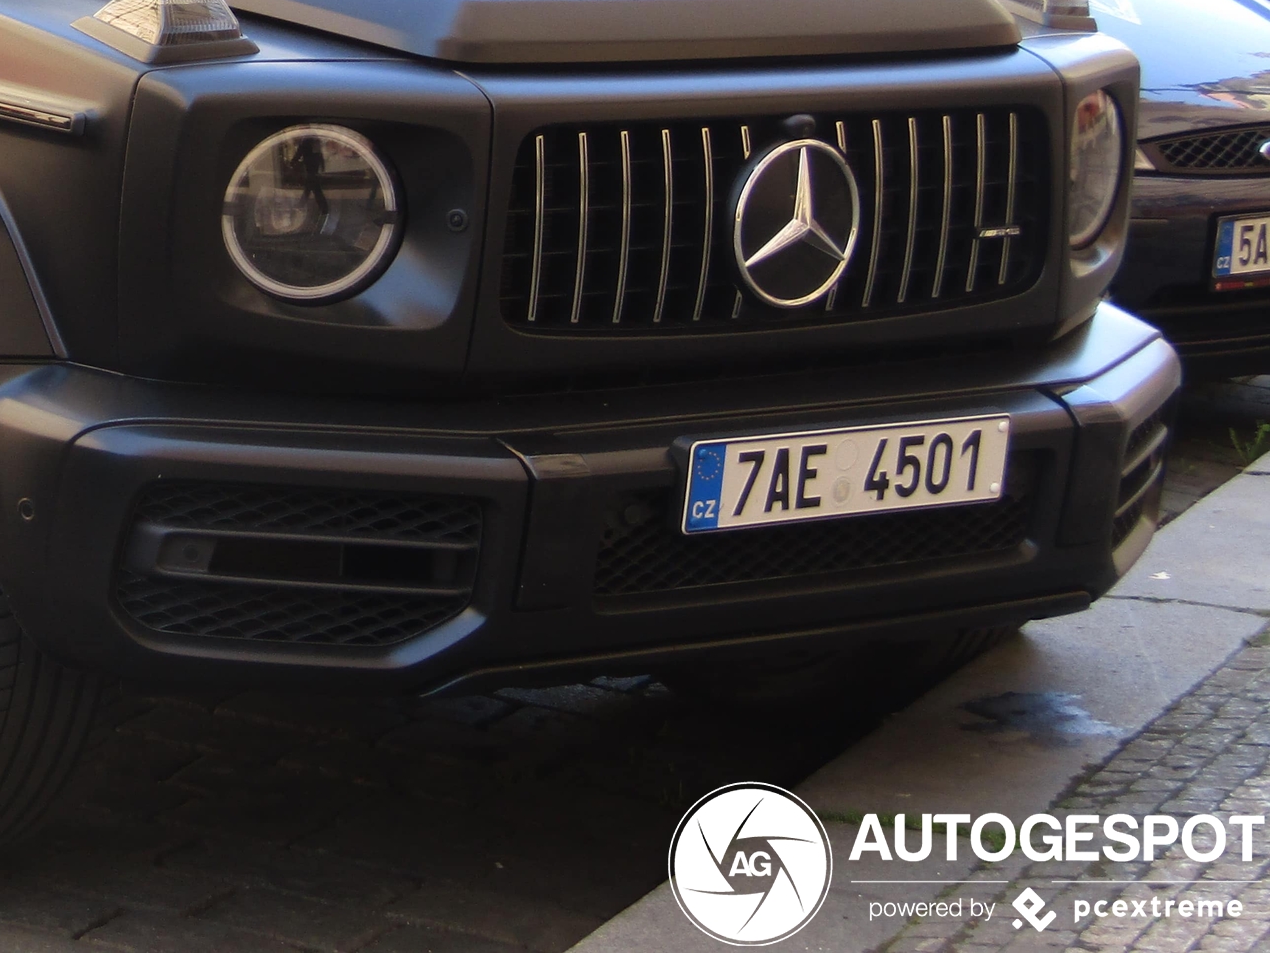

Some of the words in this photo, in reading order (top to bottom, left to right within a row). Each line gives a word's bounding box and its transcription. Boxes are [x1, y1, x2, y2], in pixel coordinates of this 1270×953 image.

[1217, 256, 1230, 268] CZ
[732, 445, 828, 516] 7AE
[863, 429, 982, 501] 4501
[692, 500, 715, 519] CZ
